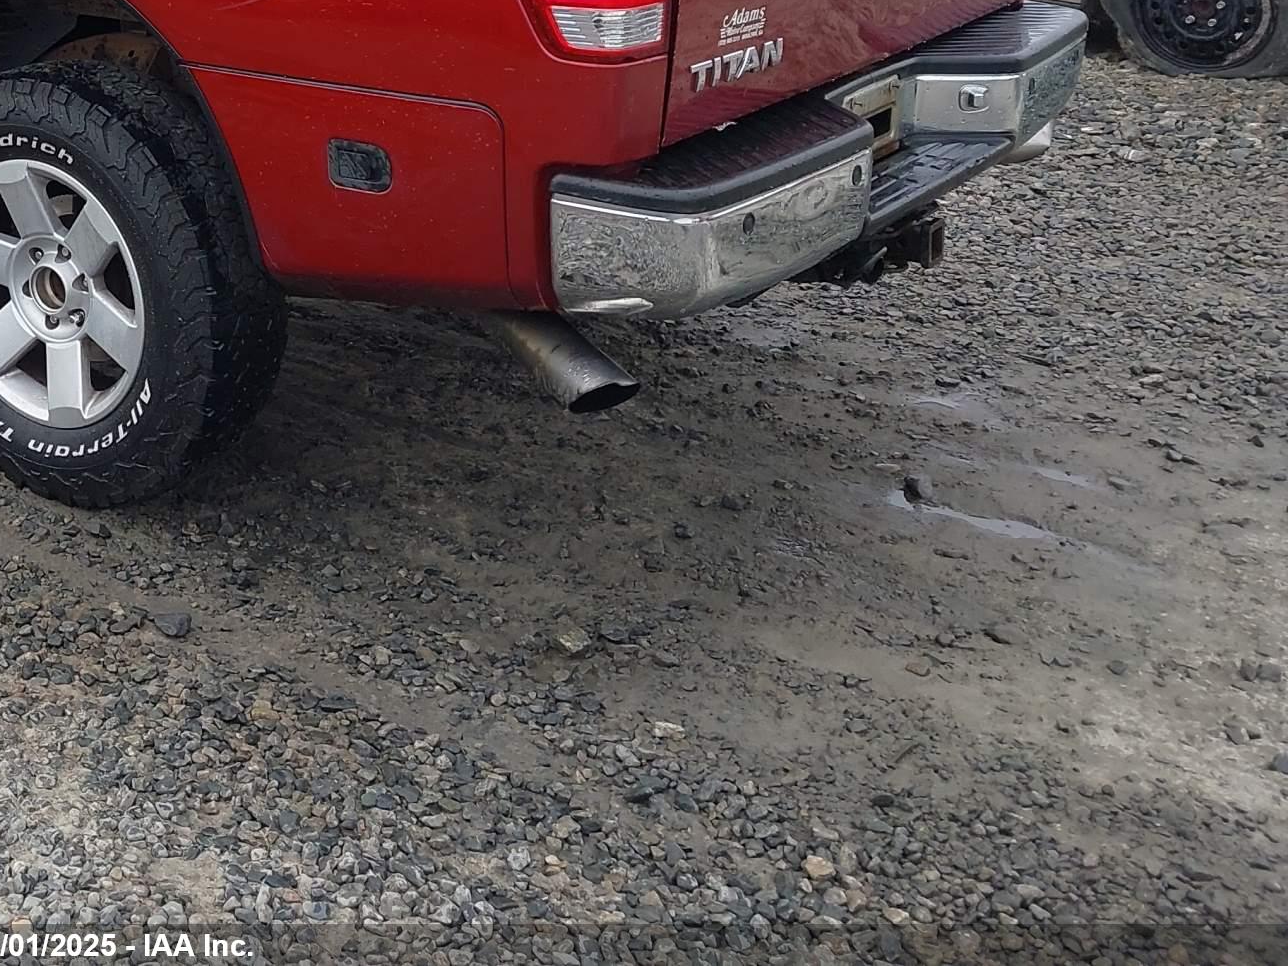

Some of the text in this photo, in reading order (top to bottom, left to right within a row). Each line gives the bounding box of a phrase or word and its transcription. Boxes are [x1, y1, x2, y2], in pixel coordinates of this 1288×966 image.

[722, 6, 767, 28] Adams
[690, 37, 784, 93] TITAN
[27, 378, 152, 459] All-Terrain
